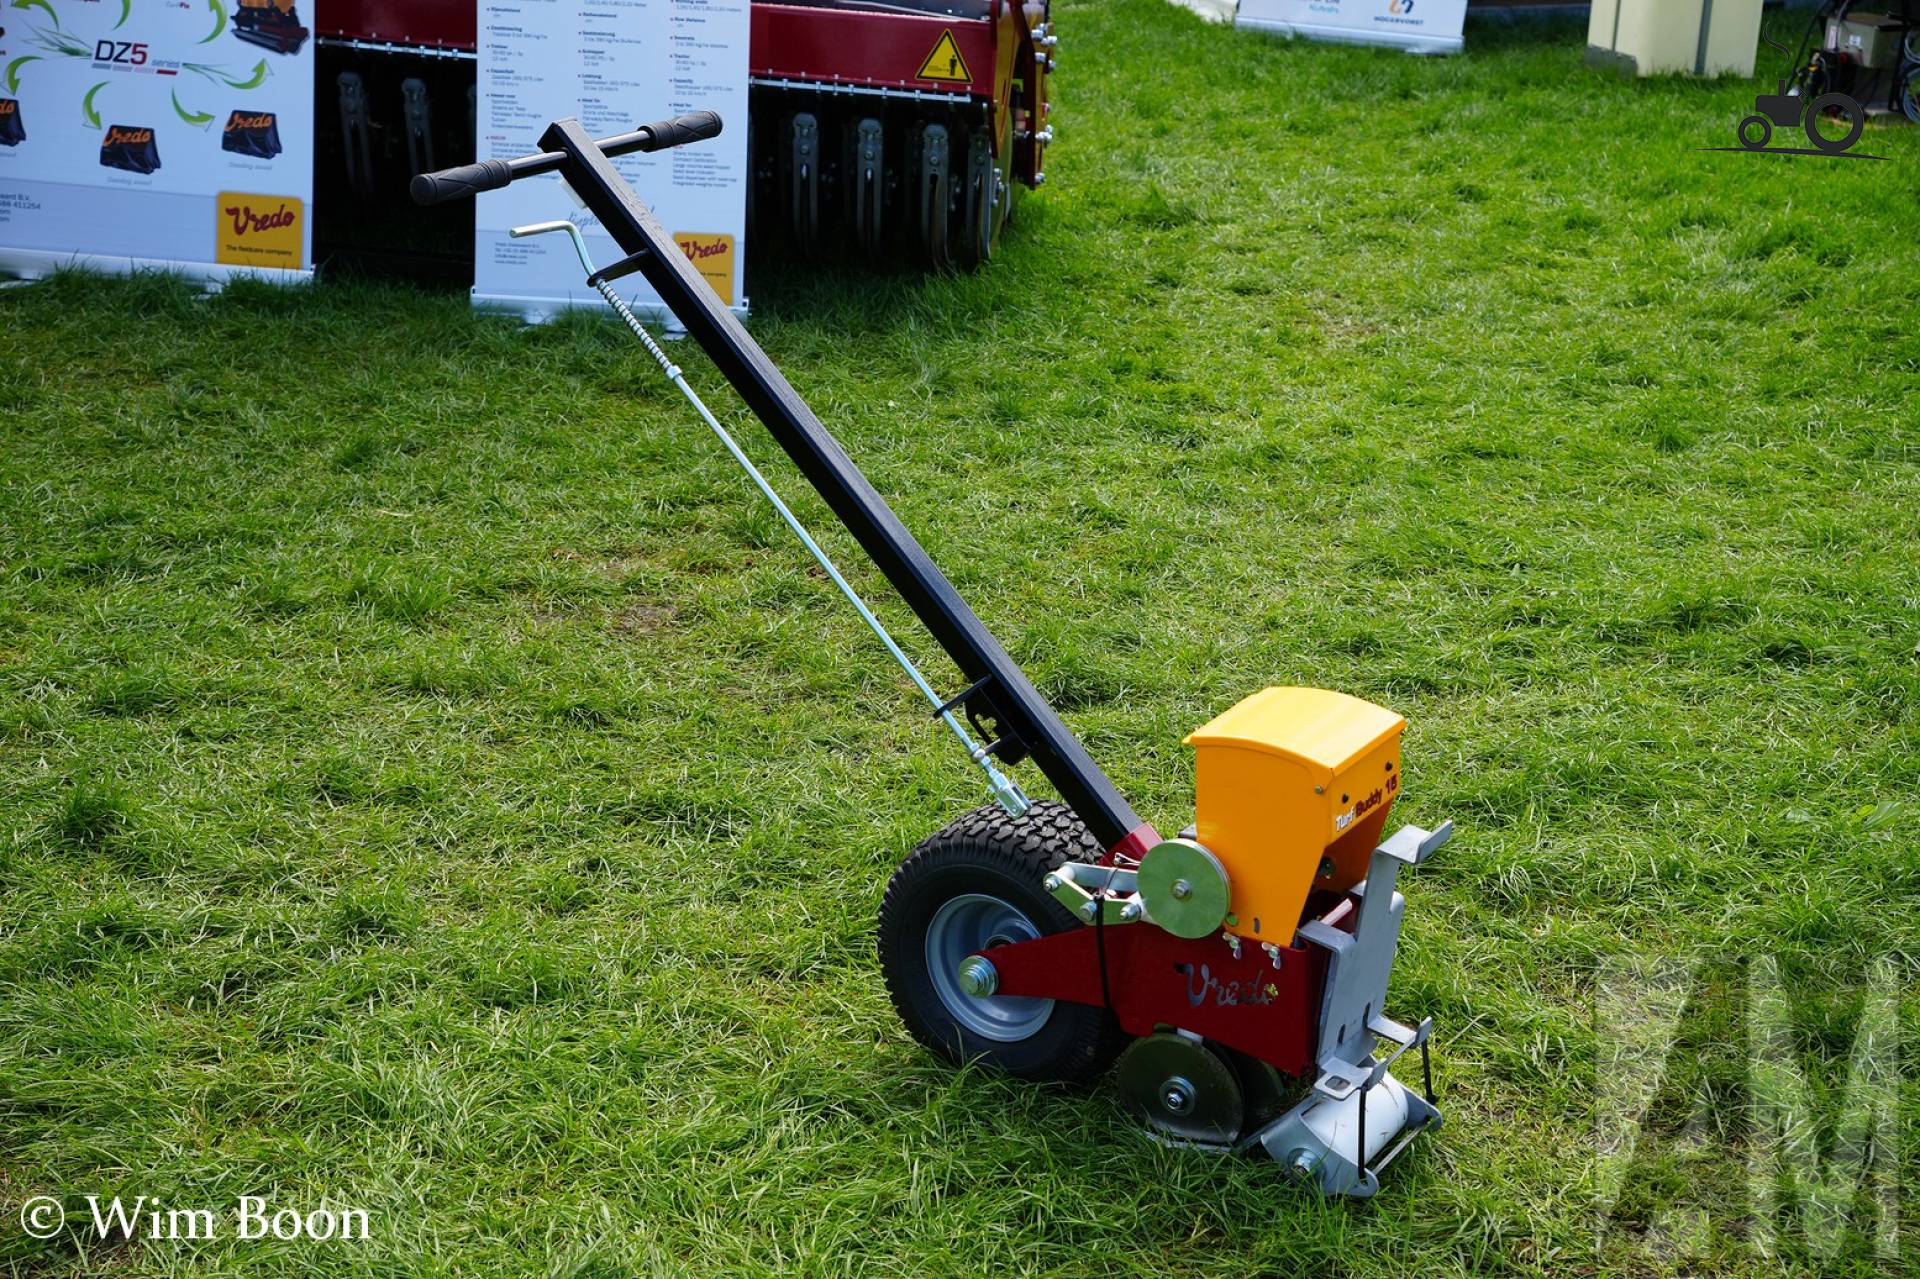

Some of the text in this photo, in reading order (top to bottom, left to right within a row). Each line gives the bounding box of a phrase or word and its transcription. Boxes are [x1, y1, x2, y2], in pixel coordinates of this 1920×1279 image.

[95, 39, 150, 65] DZ5
[225, 203, 296, 236] Vredo
[680, 237, 728, 262] Vredo
[1335, 805, 1354, 833] Turf
[1355, 788, 1383, 818] Buddy
[1174, 962, 1279, 1008] Vredo
